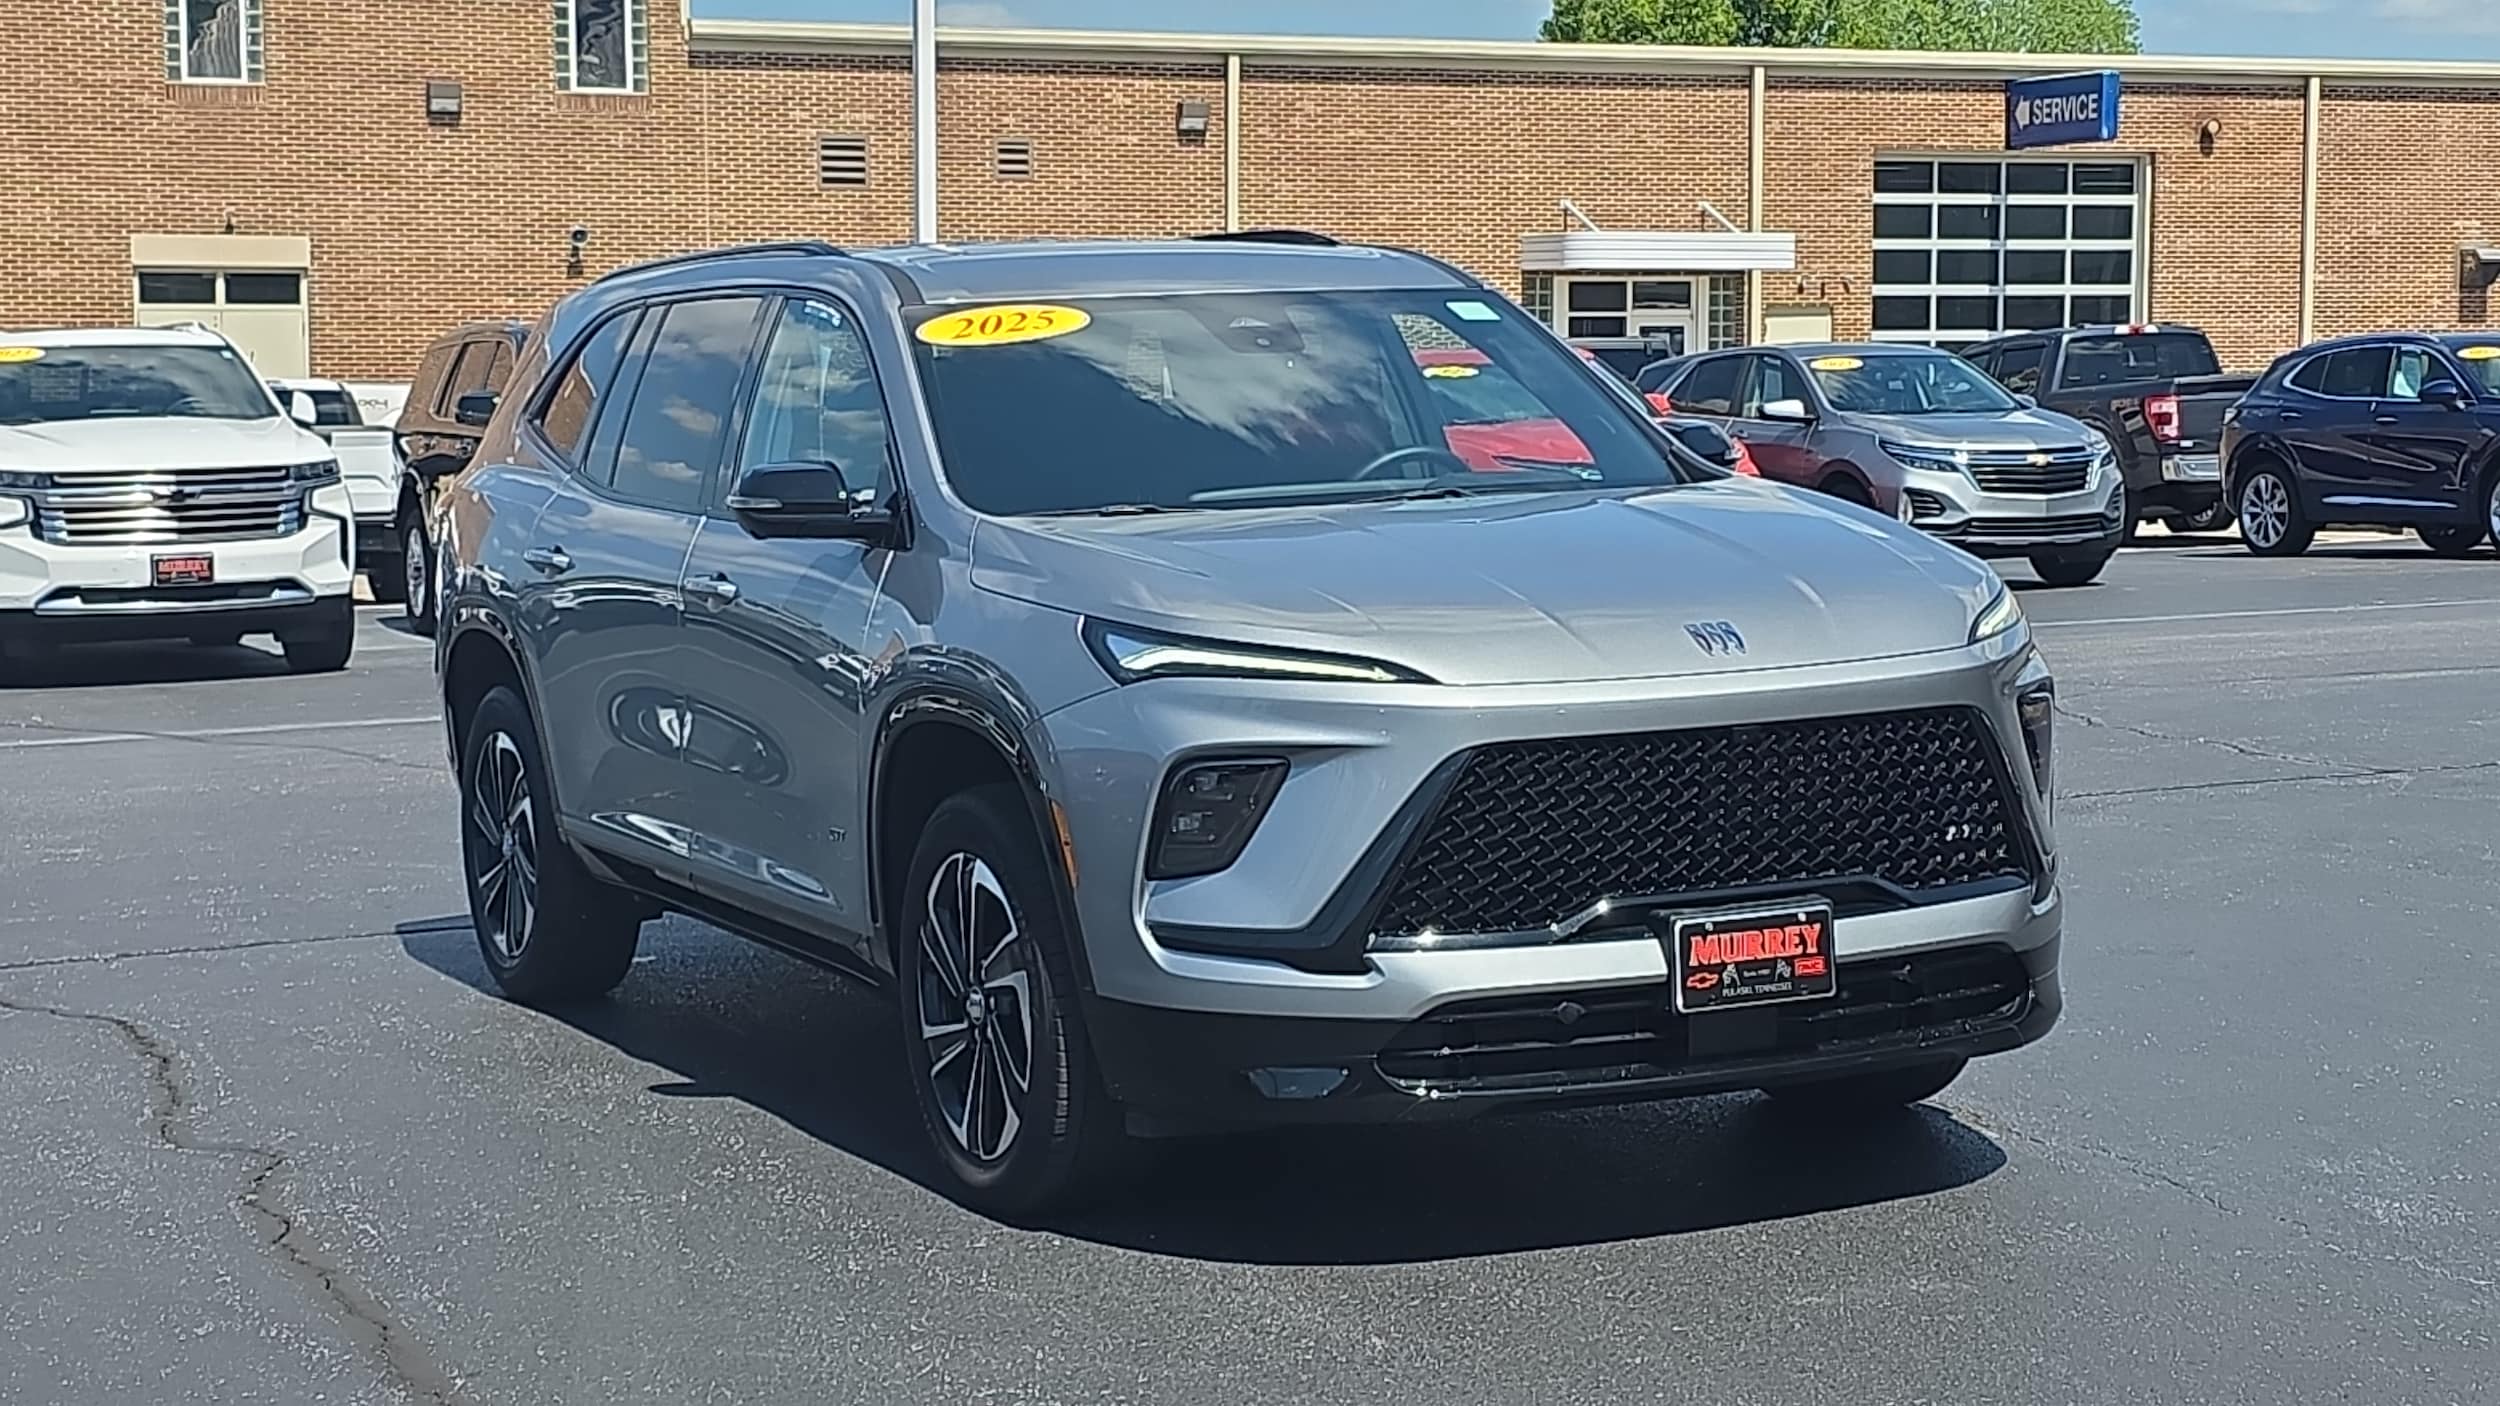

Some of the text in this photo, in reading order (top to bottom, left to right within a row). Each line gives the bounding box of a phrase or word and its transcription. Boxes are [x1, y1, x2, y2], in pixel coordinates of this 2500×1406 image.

[2032, 93, 2099, 125] SERVICE
[951, 310, 1057, 340] 2025
[1689, 922, 1822, 967] MURREY
